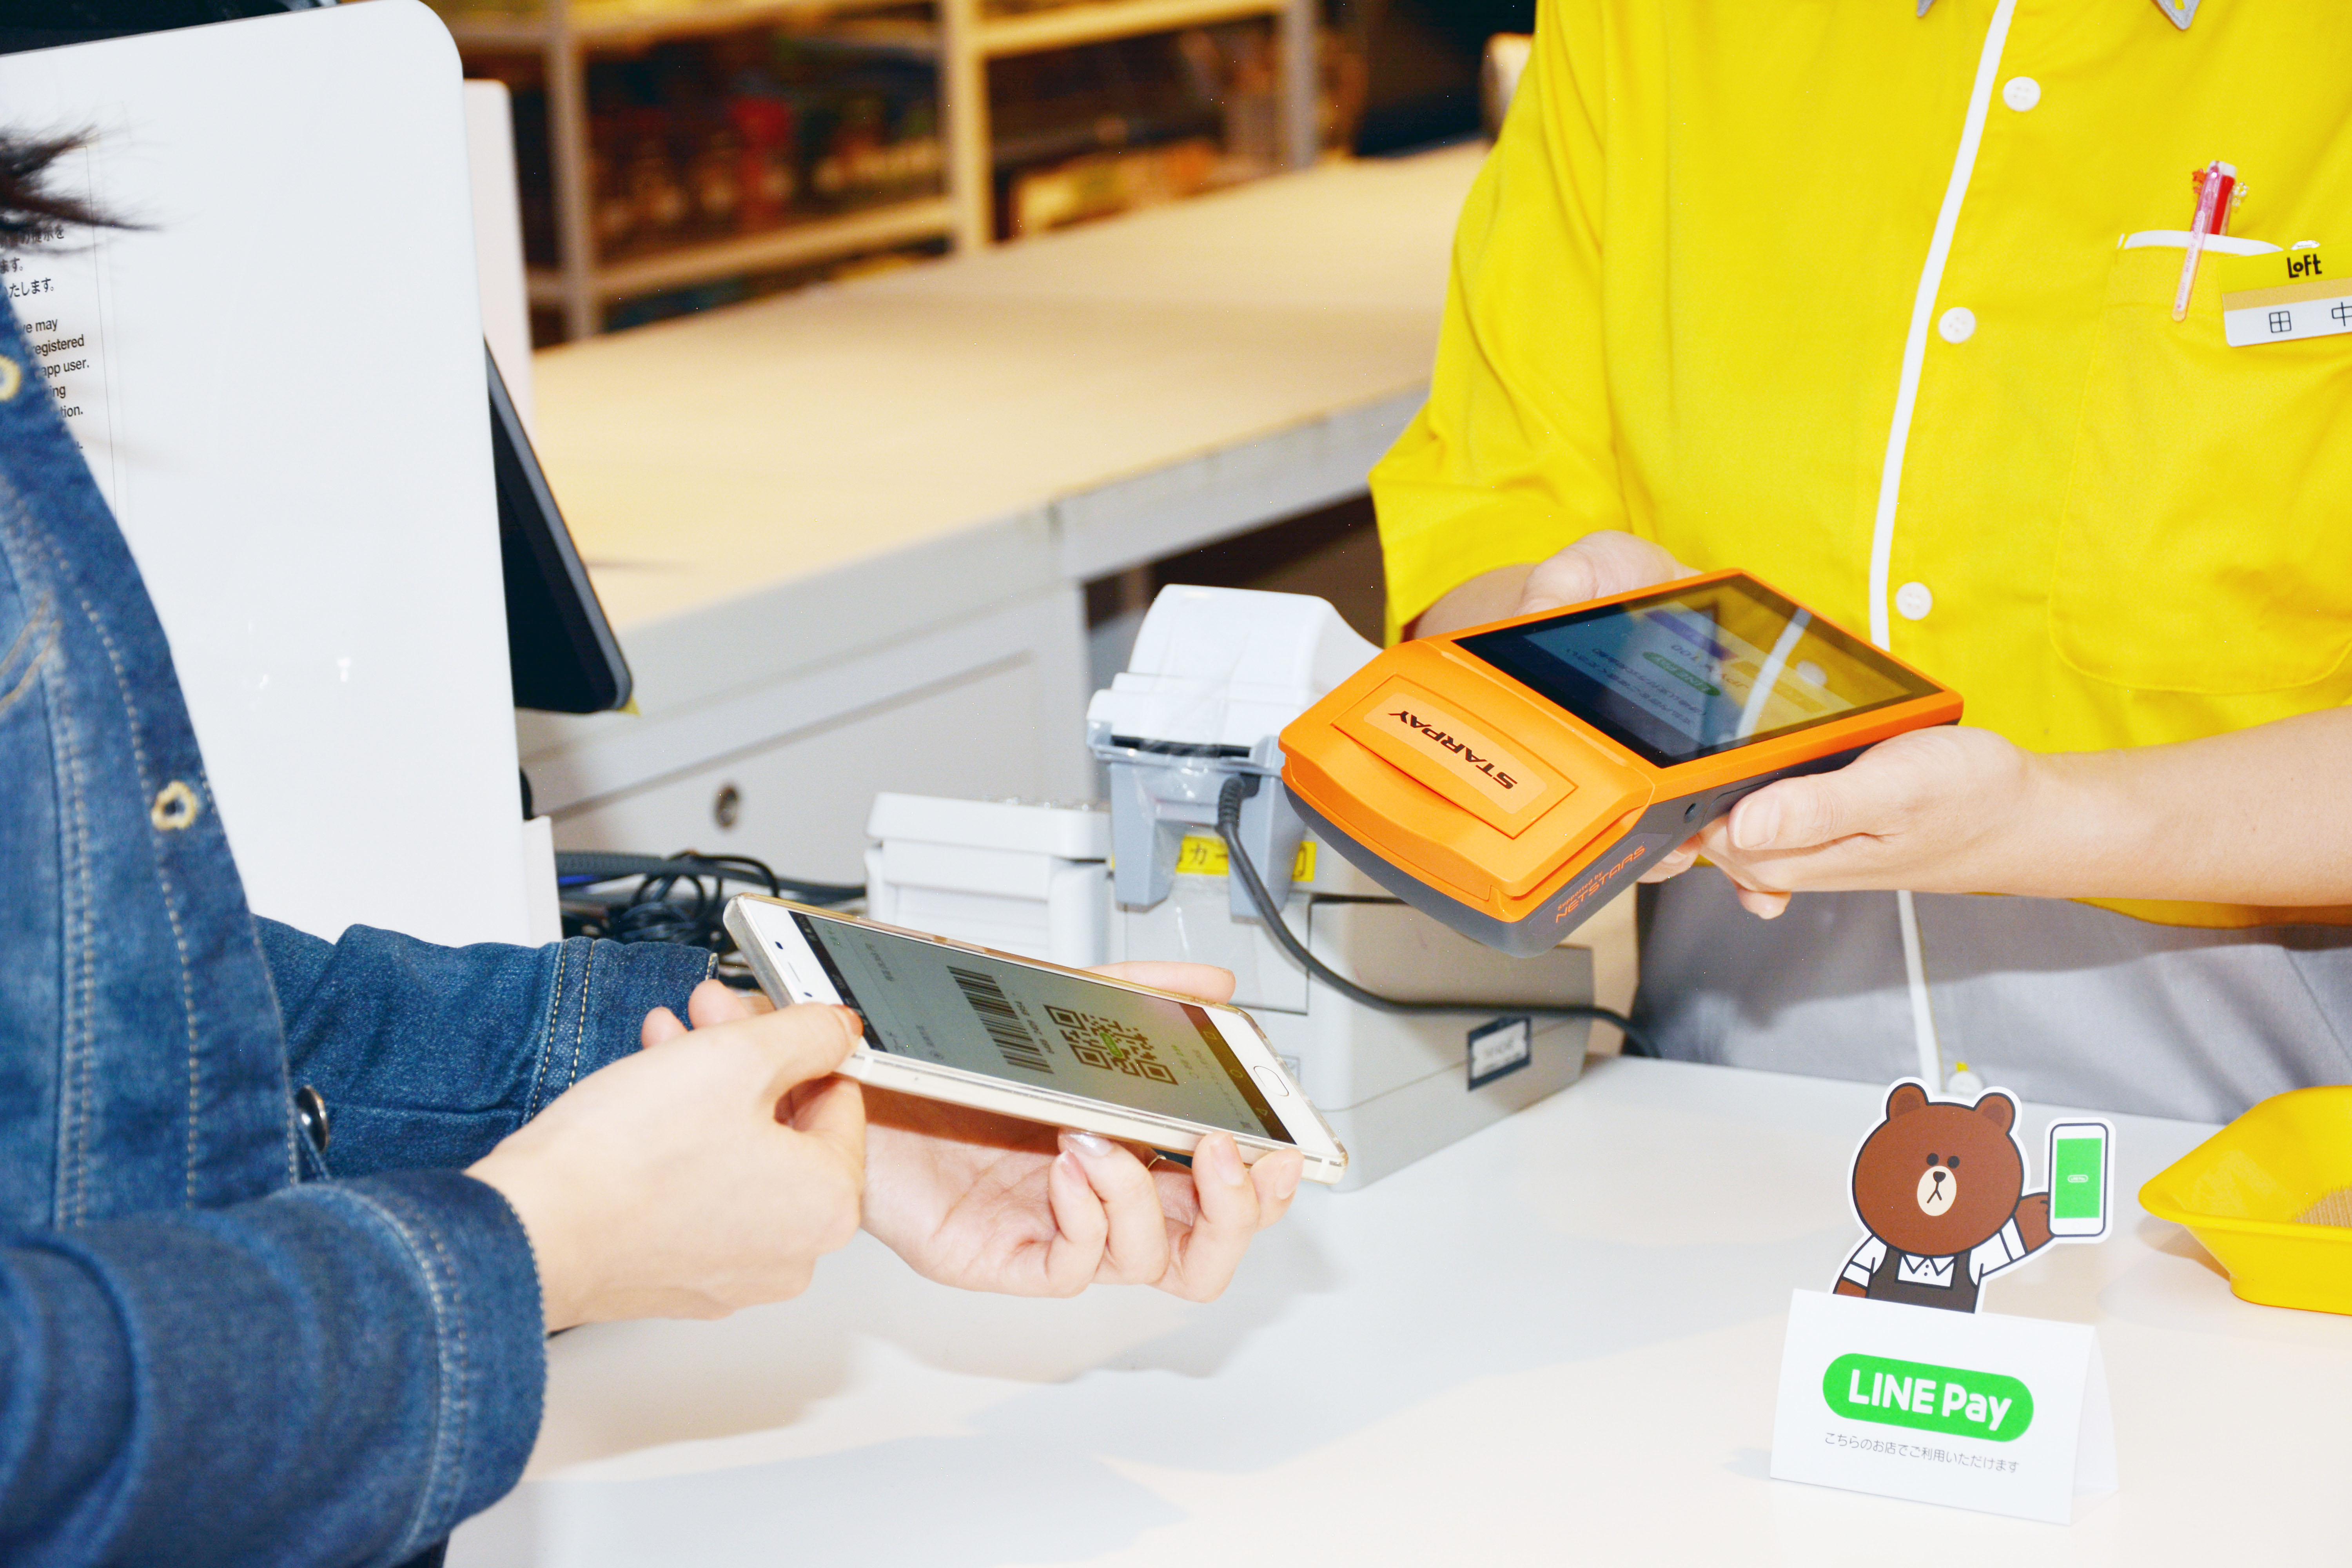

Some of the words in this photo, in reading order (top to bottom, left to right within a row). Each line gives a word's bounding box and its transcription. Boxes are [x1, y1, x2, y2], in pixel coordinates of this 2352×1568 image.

[35, 319, 58, 332] may
[64, 359, 89, 372] user.
[1388, 710, 1518, 789] STARPAY
[1555, 845, 1646, 924] NETSTARS
[1557, 879, 1593, 911] Supported
[1594, 871, 1604, 881] by
[1849, 1369, 1936, 1414] LINE
[1942, 1383, 2013, 1431] Pay
[1825, 1432, 2020, 1474] こちらのお店でご利用いただけます
